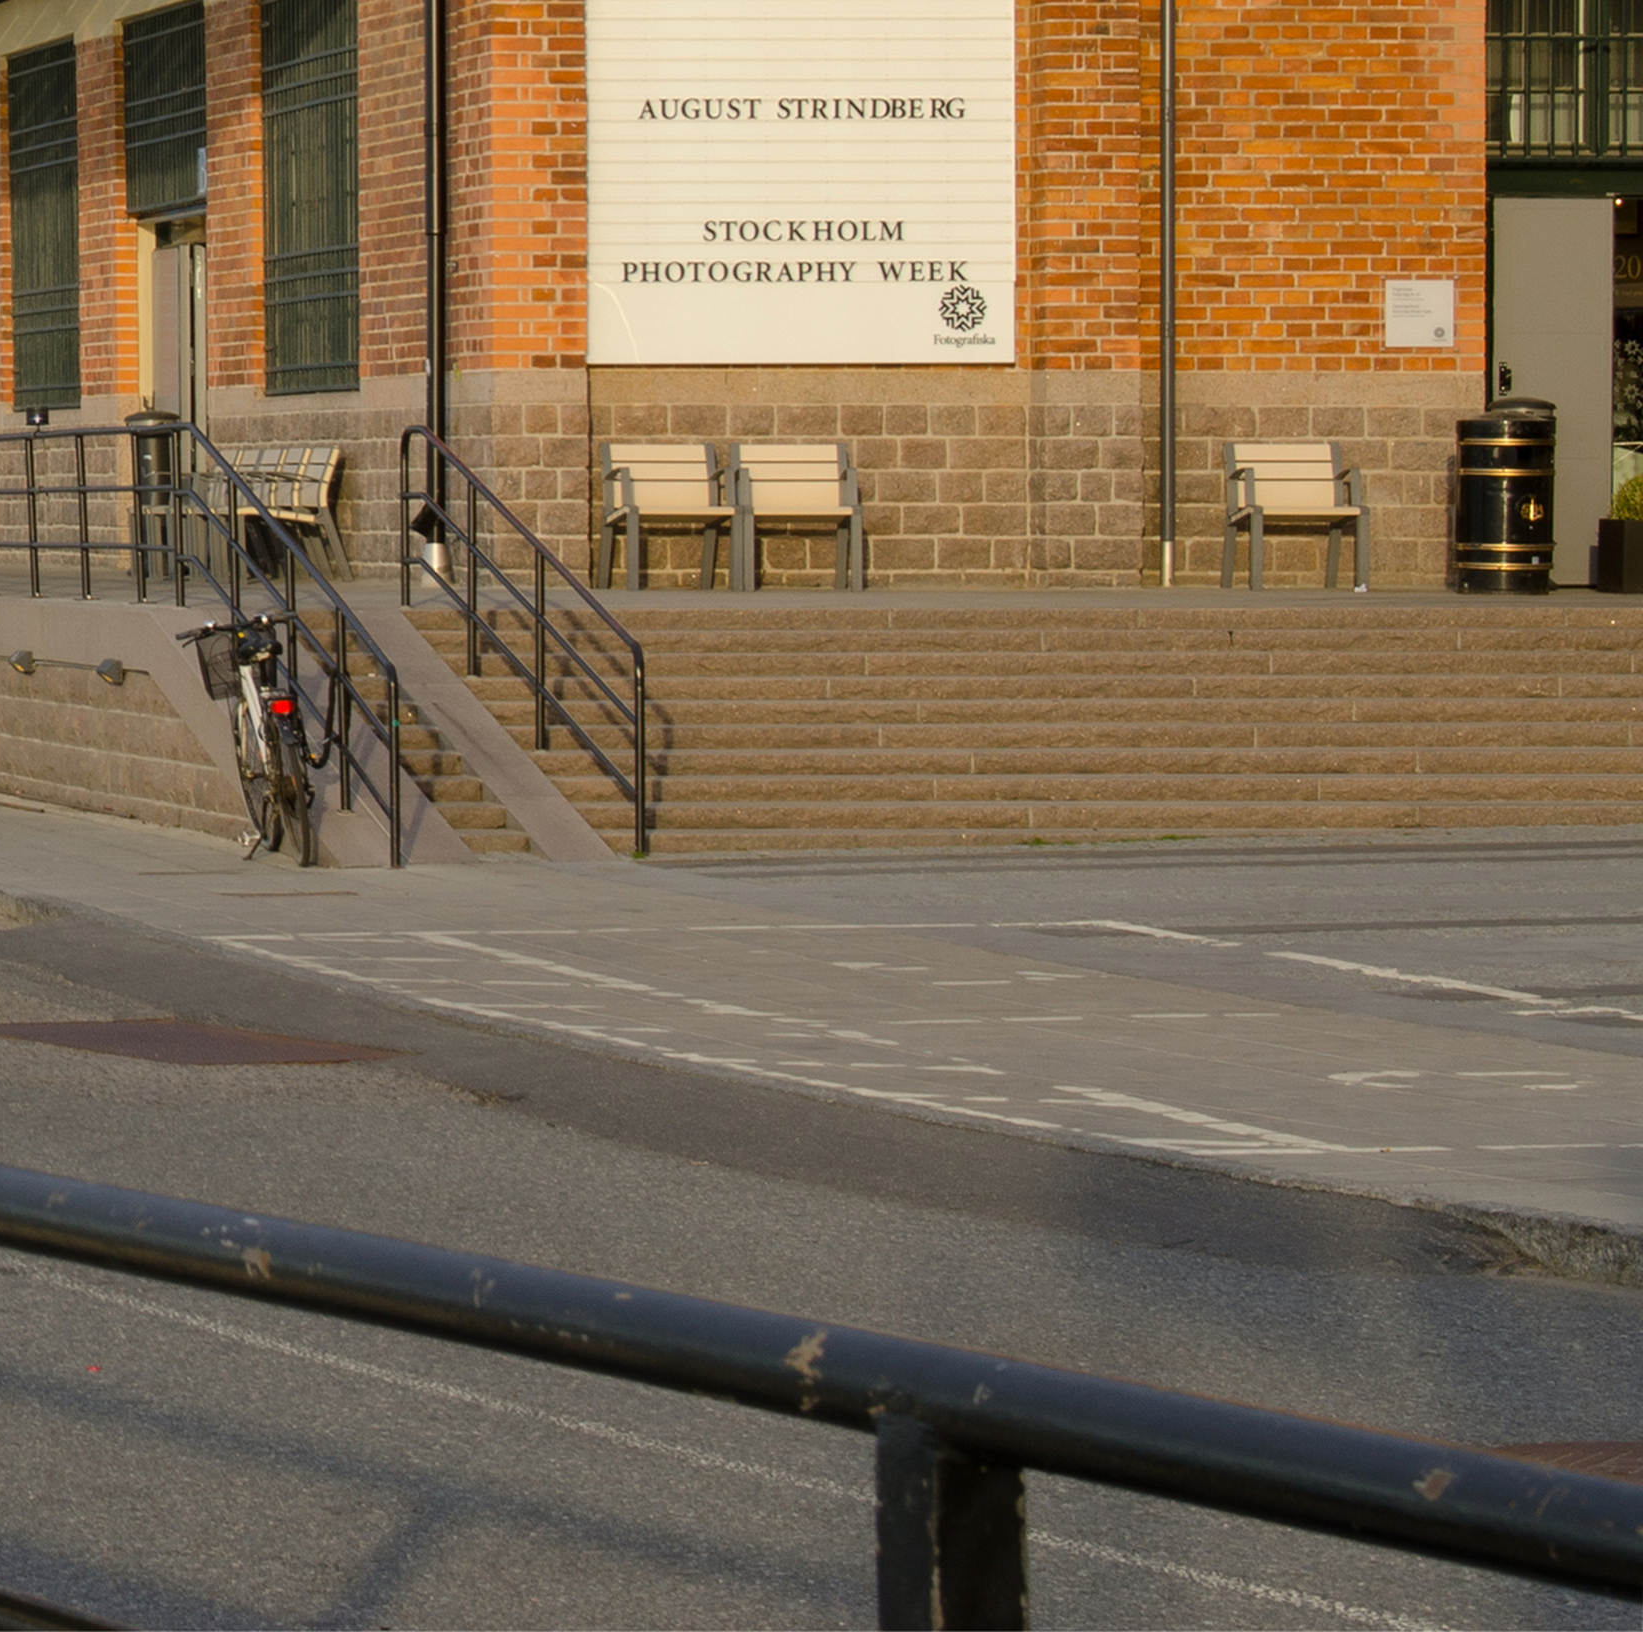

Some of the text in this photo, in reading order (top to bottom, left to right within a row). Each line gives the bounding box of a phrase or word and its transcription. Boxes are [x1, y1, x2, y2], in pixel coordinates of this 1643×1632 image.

[638, 98, 965, 120] AUGUST STRINDBERG
[703, 220, 904, 242] STOCKHOLM
[622, 261, 969, 283] PHOTOGRAPHY WEEK
[933, 333, 996, 349] Fotografiska
